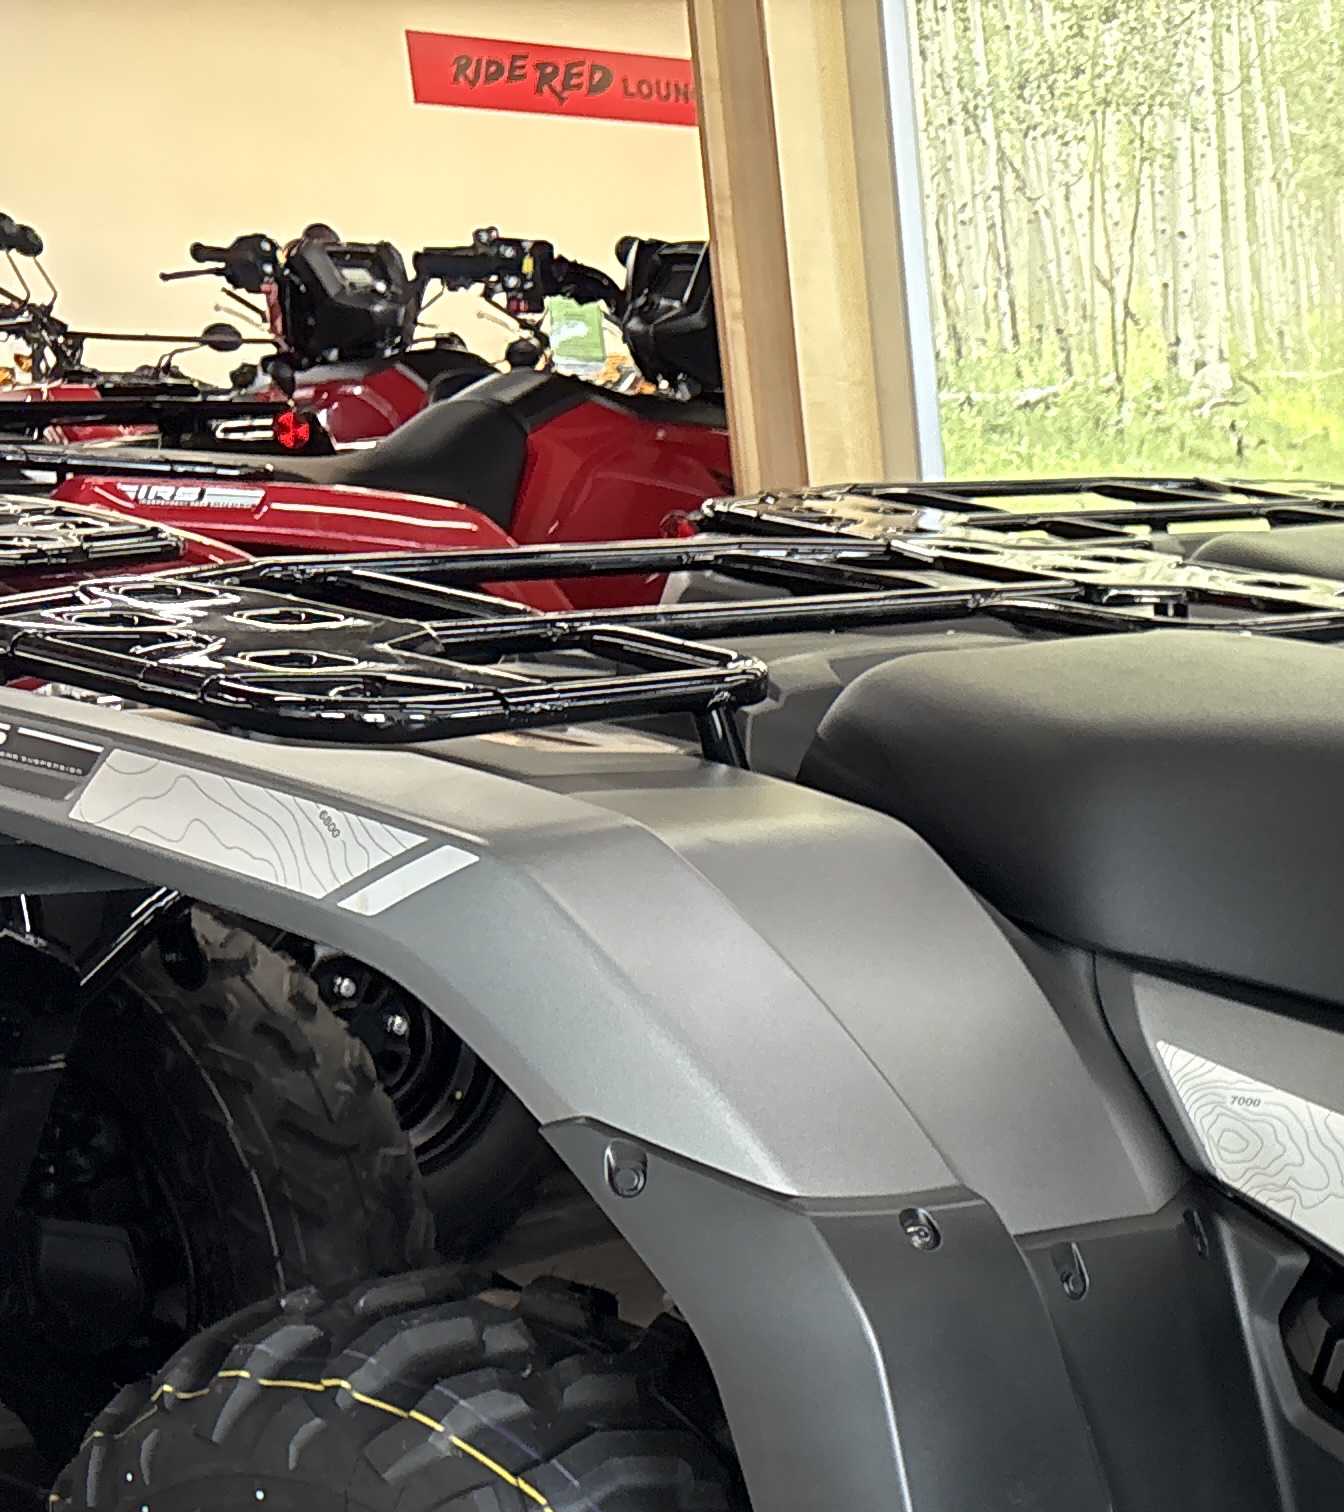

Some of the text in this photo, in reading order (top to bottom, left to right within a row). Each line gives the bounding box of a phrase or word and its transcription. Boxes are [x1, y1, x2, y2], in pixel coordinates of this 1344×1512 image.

[451, 53, 697, 105] RIDE RED LOUN
[1230, 1095, 1261, 1107] 7000
